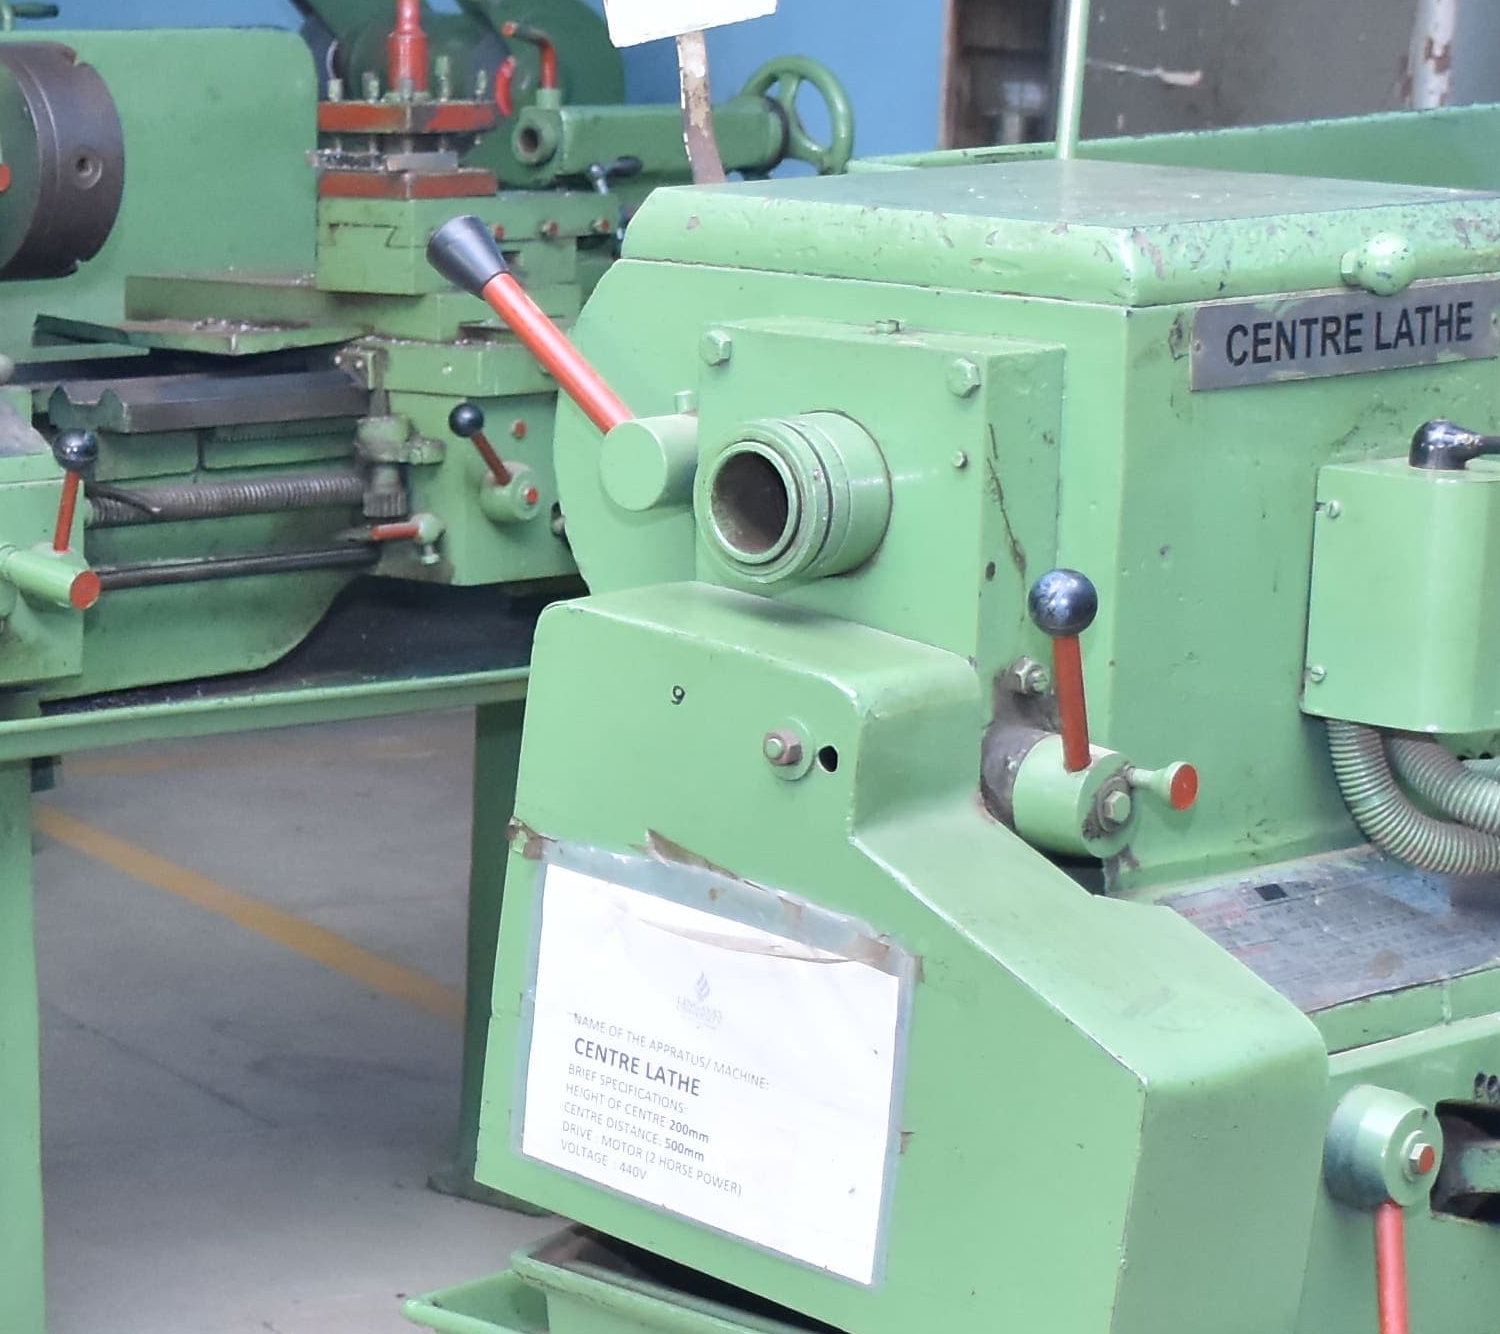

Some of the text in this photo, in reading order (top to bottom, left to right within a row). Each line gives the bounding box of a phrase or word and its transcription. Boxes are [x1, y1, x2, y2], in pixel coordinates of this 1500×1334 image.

[1225, 301, 1474, 367] CENTRE LATHE
[572, 1012, 606, 1034] NAME
[608, 1024, 623, 1039] OF
[627, 1030, 646, 1047] THE
[649, 1039, 711, 1069] APPRATUS/
[574, 1037, 701, 1097] CENTRE LATHE
[568, 1063, 597, 1082] BRIEF
[564, 1101, 603, 1126] CENTRE
[664, 1137, 705, 1162] 500mm
[566, 1082, 605, 1106] HEIGHT
[608, 1097, 622, 1111] OF
[669, 1119, 709, 1144] 200mm
[560, 1138, 608, 1167] VOLTAGE
[562, 1120, 592, 1141] DRIVE
[601, 1134, 643, 1159] MOTOR
[659, 1155, 693, 1179] HORSE
[696, 1168, 742, 1198] POWER)
